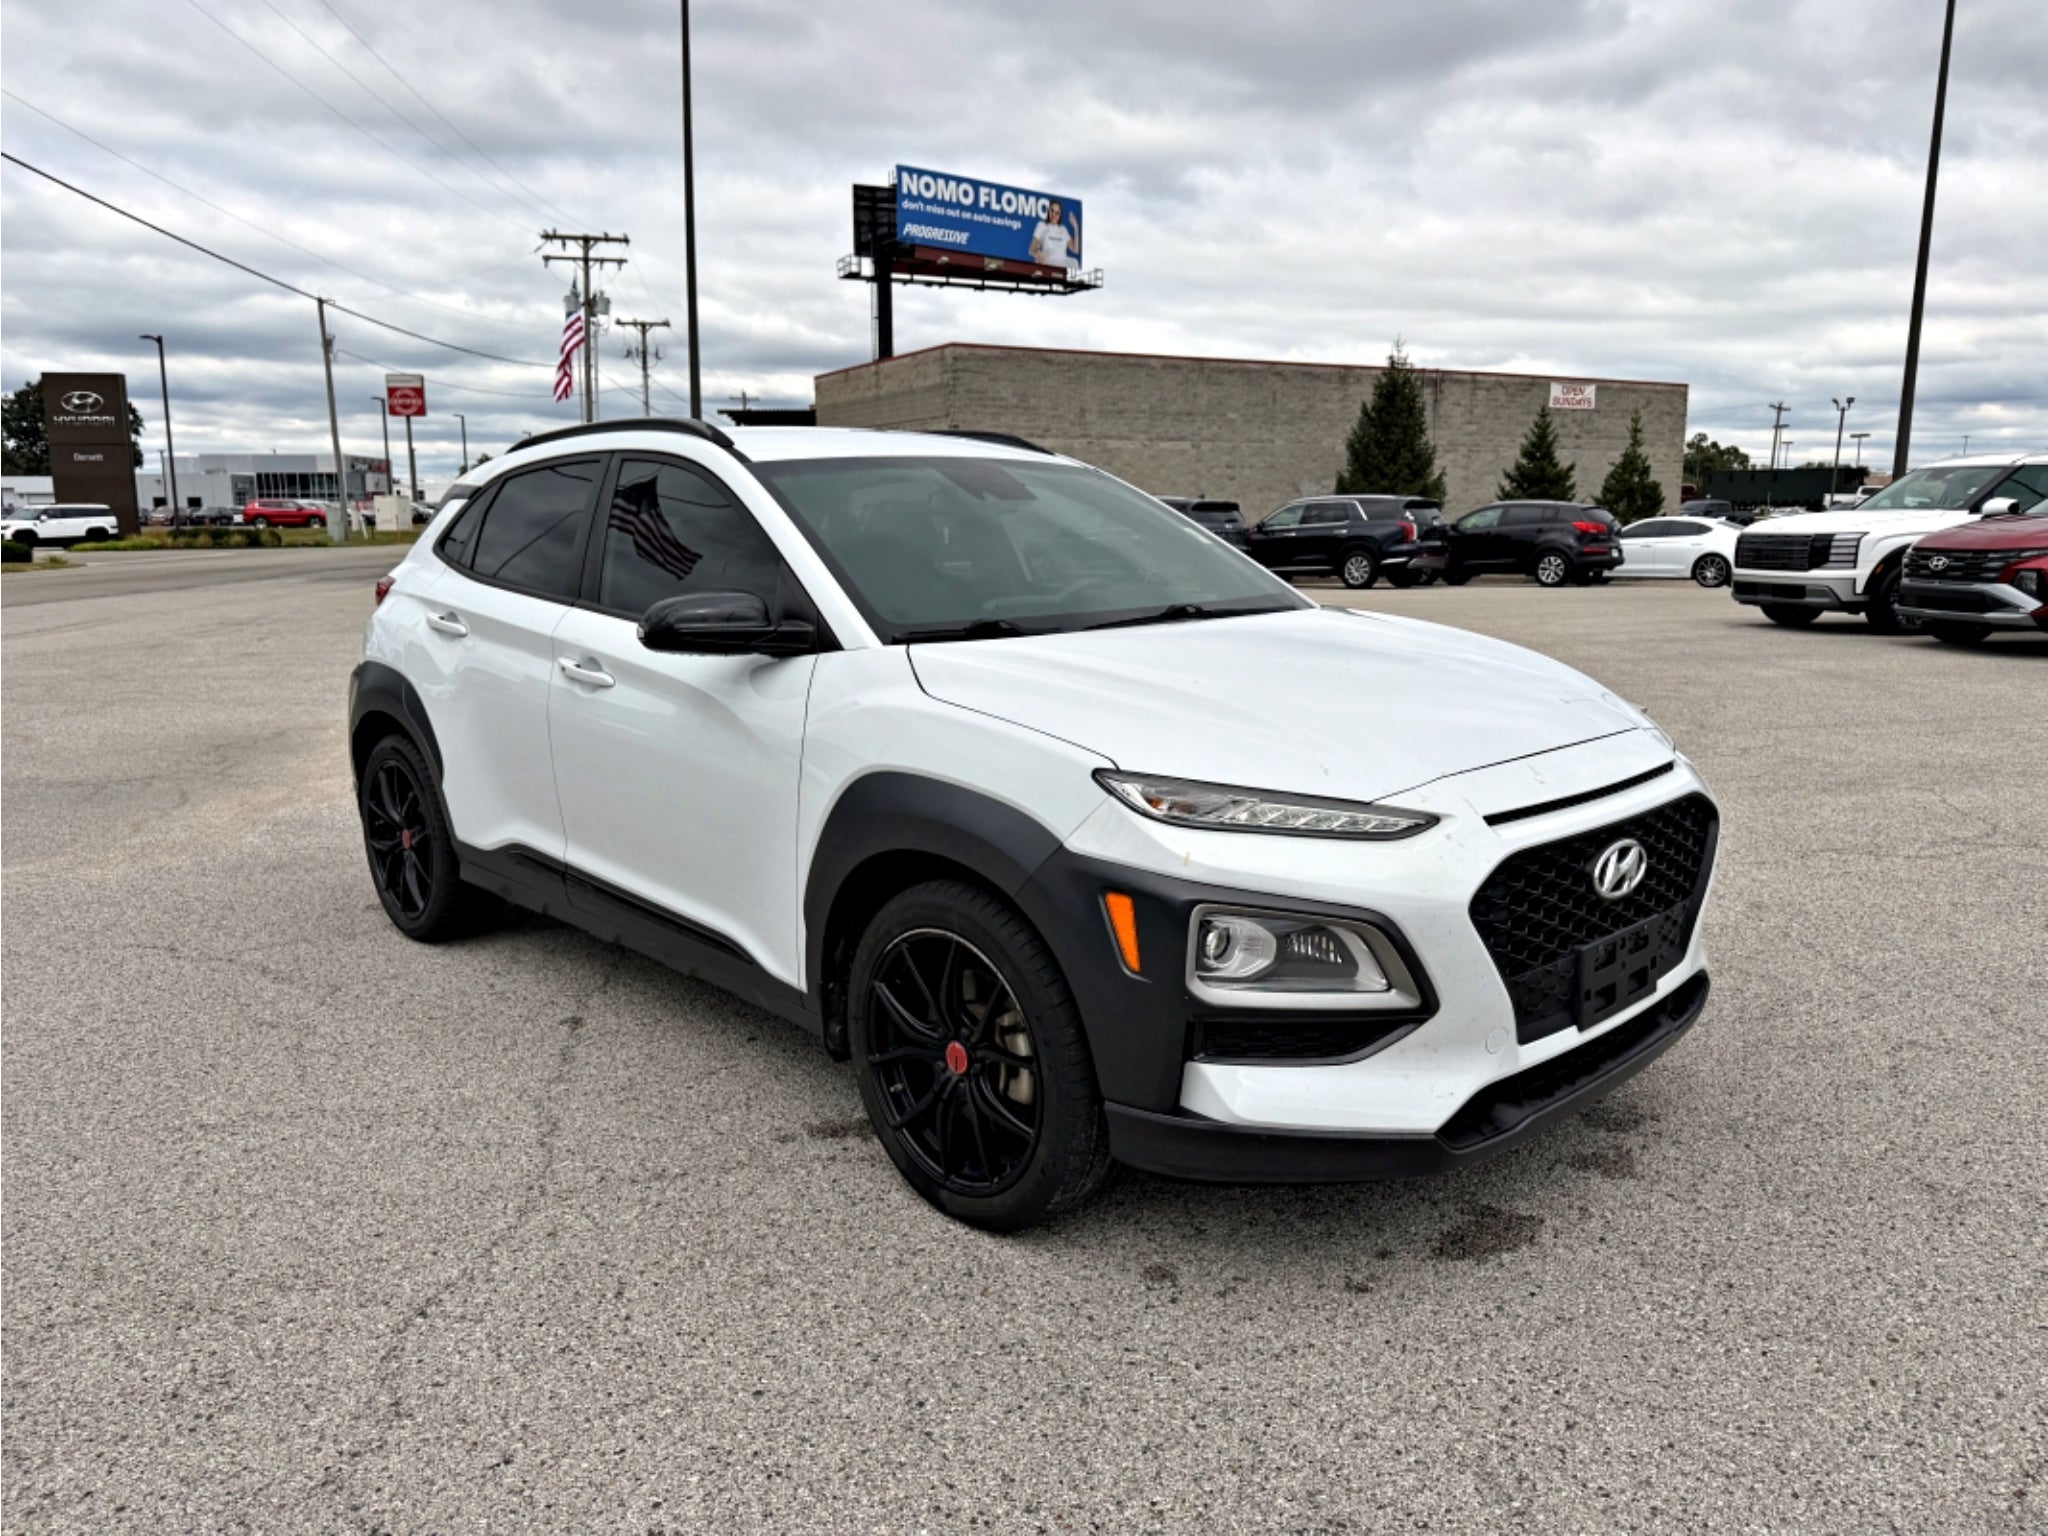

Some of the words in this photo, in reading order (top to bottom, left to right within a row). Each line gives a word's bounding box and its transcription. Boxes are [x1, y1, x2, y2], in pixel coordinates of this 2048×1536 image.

[901, 171, 974, 206] NOMO
[980, 186, 1051, 220] FLOMO
[901, 199, 924, 211] don't
[926, 204, 945, 215] miss
[946, 208, 961, 218] out
[962, 211, 972, 220] on
[973, 212, 991, 223] auto
[992, 216, 1022, 230] savings
[903, 222, 970, 244] PROGRESSIVE
[1562, 385, 1584, 396] OPEN
[1552, 397, 1592, 408] SUNDAYS
